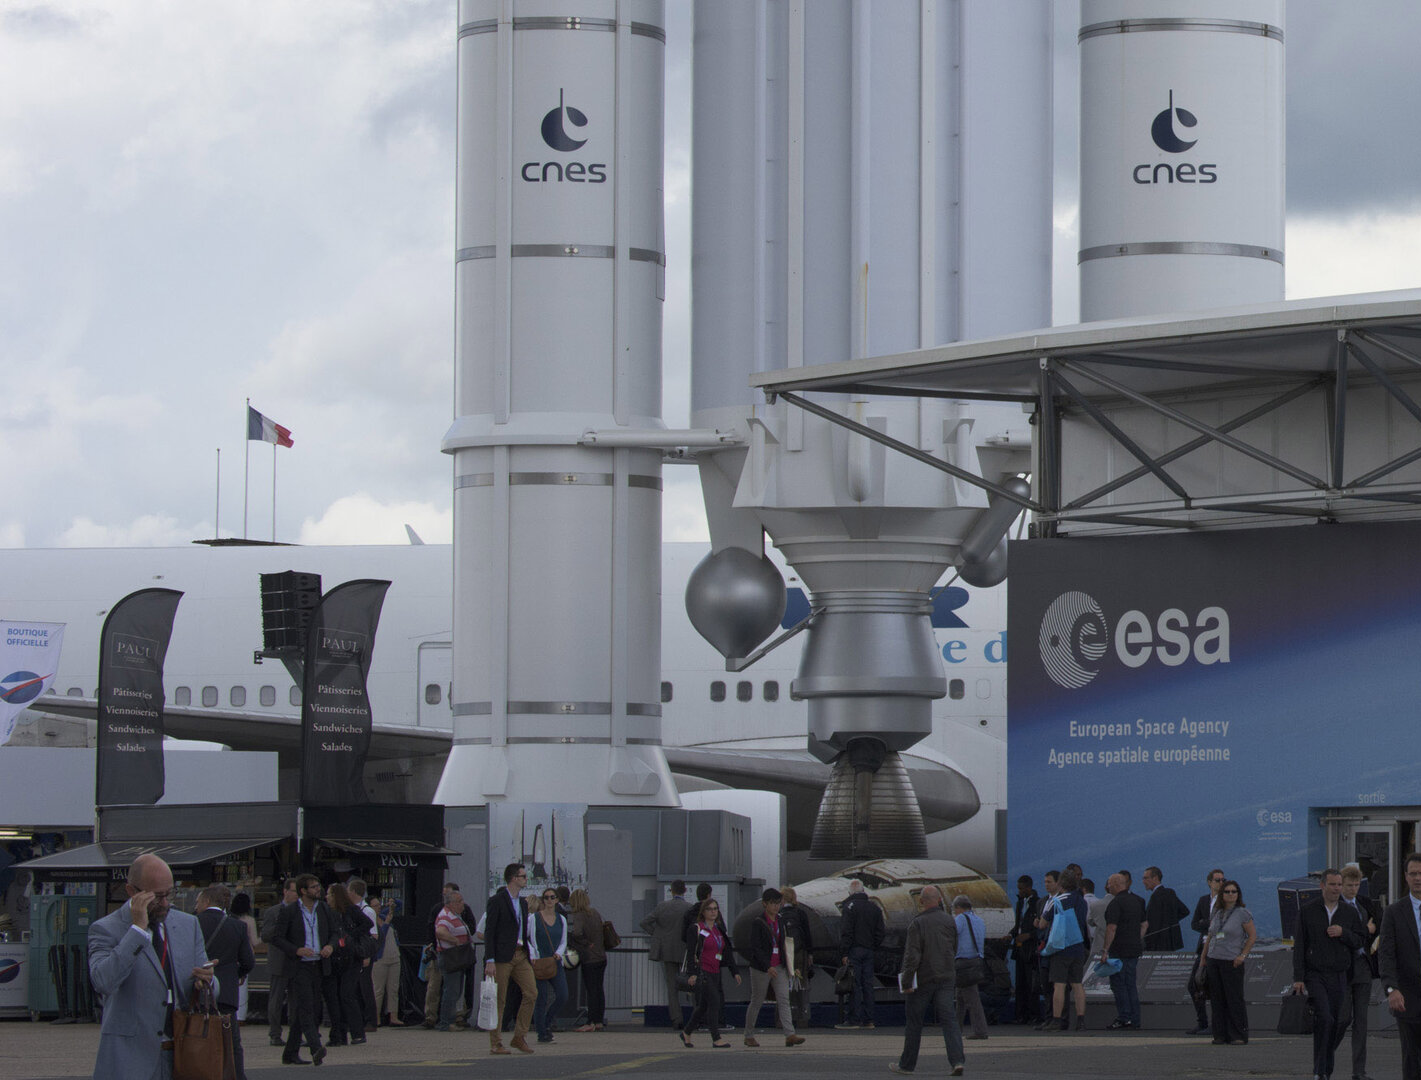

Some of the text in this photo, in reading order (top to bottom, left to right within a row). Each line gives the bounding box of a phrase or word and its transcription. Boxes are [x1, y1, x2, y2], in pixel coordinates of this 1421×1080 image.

[521, 162, 607, 183] cnes
[1133, 163, 1217, 184] cnes
[7, 628, 48, 638] BOUTIQUE
[1114, 606, 1230, 668] esa
[6, 638, 49, 648] OFFICIELLE
[116, 641, 152, 658] PAUL
[321, 637, 360, 653] PAUL
[113, 687, 153, 700] Pâtisseries
[318, 684, 363, 696] Pâtisseries
[106, 705, 159, 718] Viennoiseries
[310, 703, 368, 715] Viennoiseries
[108, 724, 156, 735] Sandwiches
[312, 722, 363, 734] Sandwiches
[1069, 717, 1230, 740] European Space Agency
[116, 743, 147, 752] Salades
[321, 742, 353, 752] Salades
[1048, 745, 1230, 768] Agence spatiale européenne
[1358, 790, 1386, 805] sortie
[1270, 810, 1292, 824] esa
[380, 854, 418, 867] PAUL
